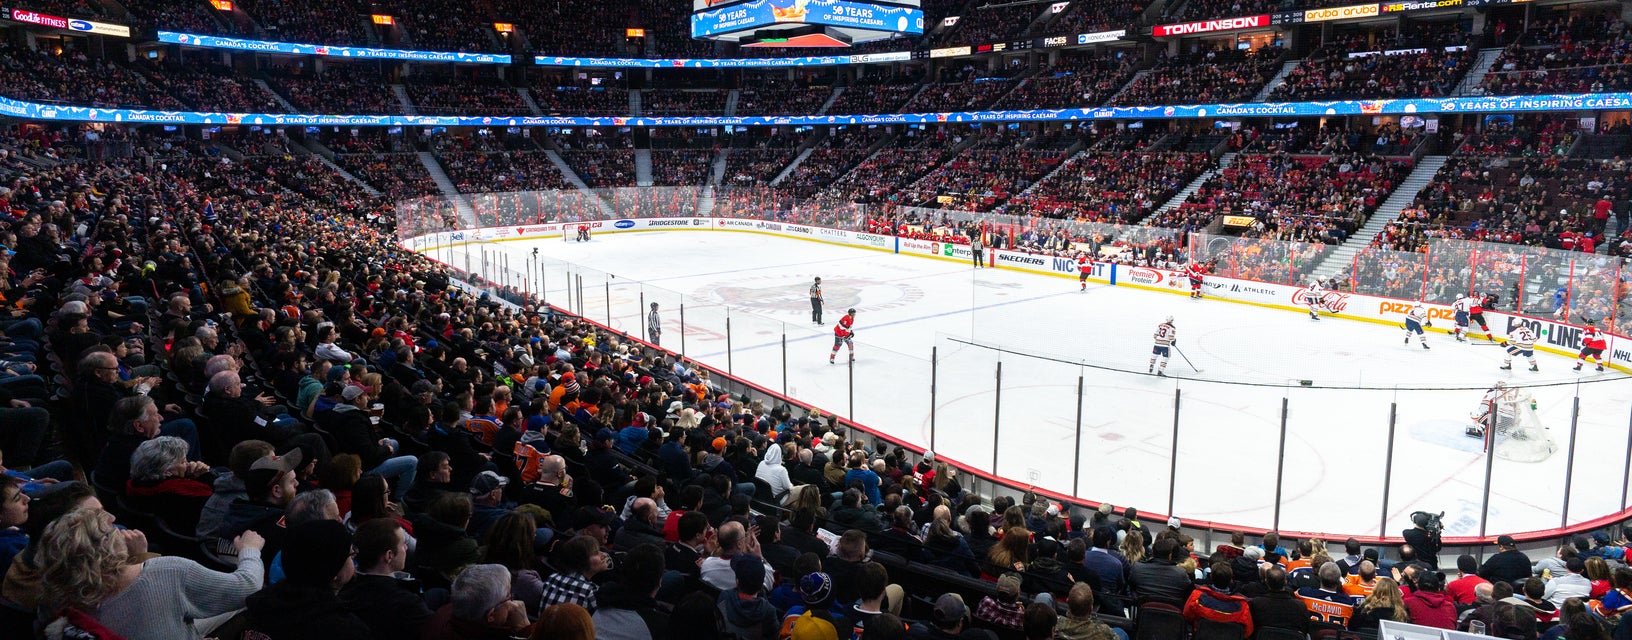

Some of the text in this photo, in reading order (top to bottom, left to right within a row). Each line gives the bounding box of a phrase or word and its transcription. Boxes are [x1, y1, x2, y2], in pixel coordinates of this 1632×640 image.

[727, 9, 747, 21] YEARS
[845, 7, 873, 18] YEARS
[1306, 10, 1339, 20] aruba
[1344, 6, 1377, 16] aruba
[41, 17, 66, 28] FITNESS
[1163, 16, 1258, 35] TOMLINSON
[216, 40, 246, 49] CANADA'S
[1460, 101, 1496, 110] YEARS
[1500, 100, 1516, 109] OF
[1520, 99, 1582, 108] INSPIRING
[1217, 106, 1255, 114] CANADA'S
[821, 228, 847, 237] CHATTERS
[856, 234, 885, 242] ALGONQUIN
[998, 254, 1045, 266] SKECHERS
[1128, 269, 1155, 279] Premier
[1244, 287, 1275, 295] ATHLETIC
[1520, 332, 1531, 341] 25
[1548, 324, 1583, 350] LINE
[1312, 602, 1342, 615] McDAVID
